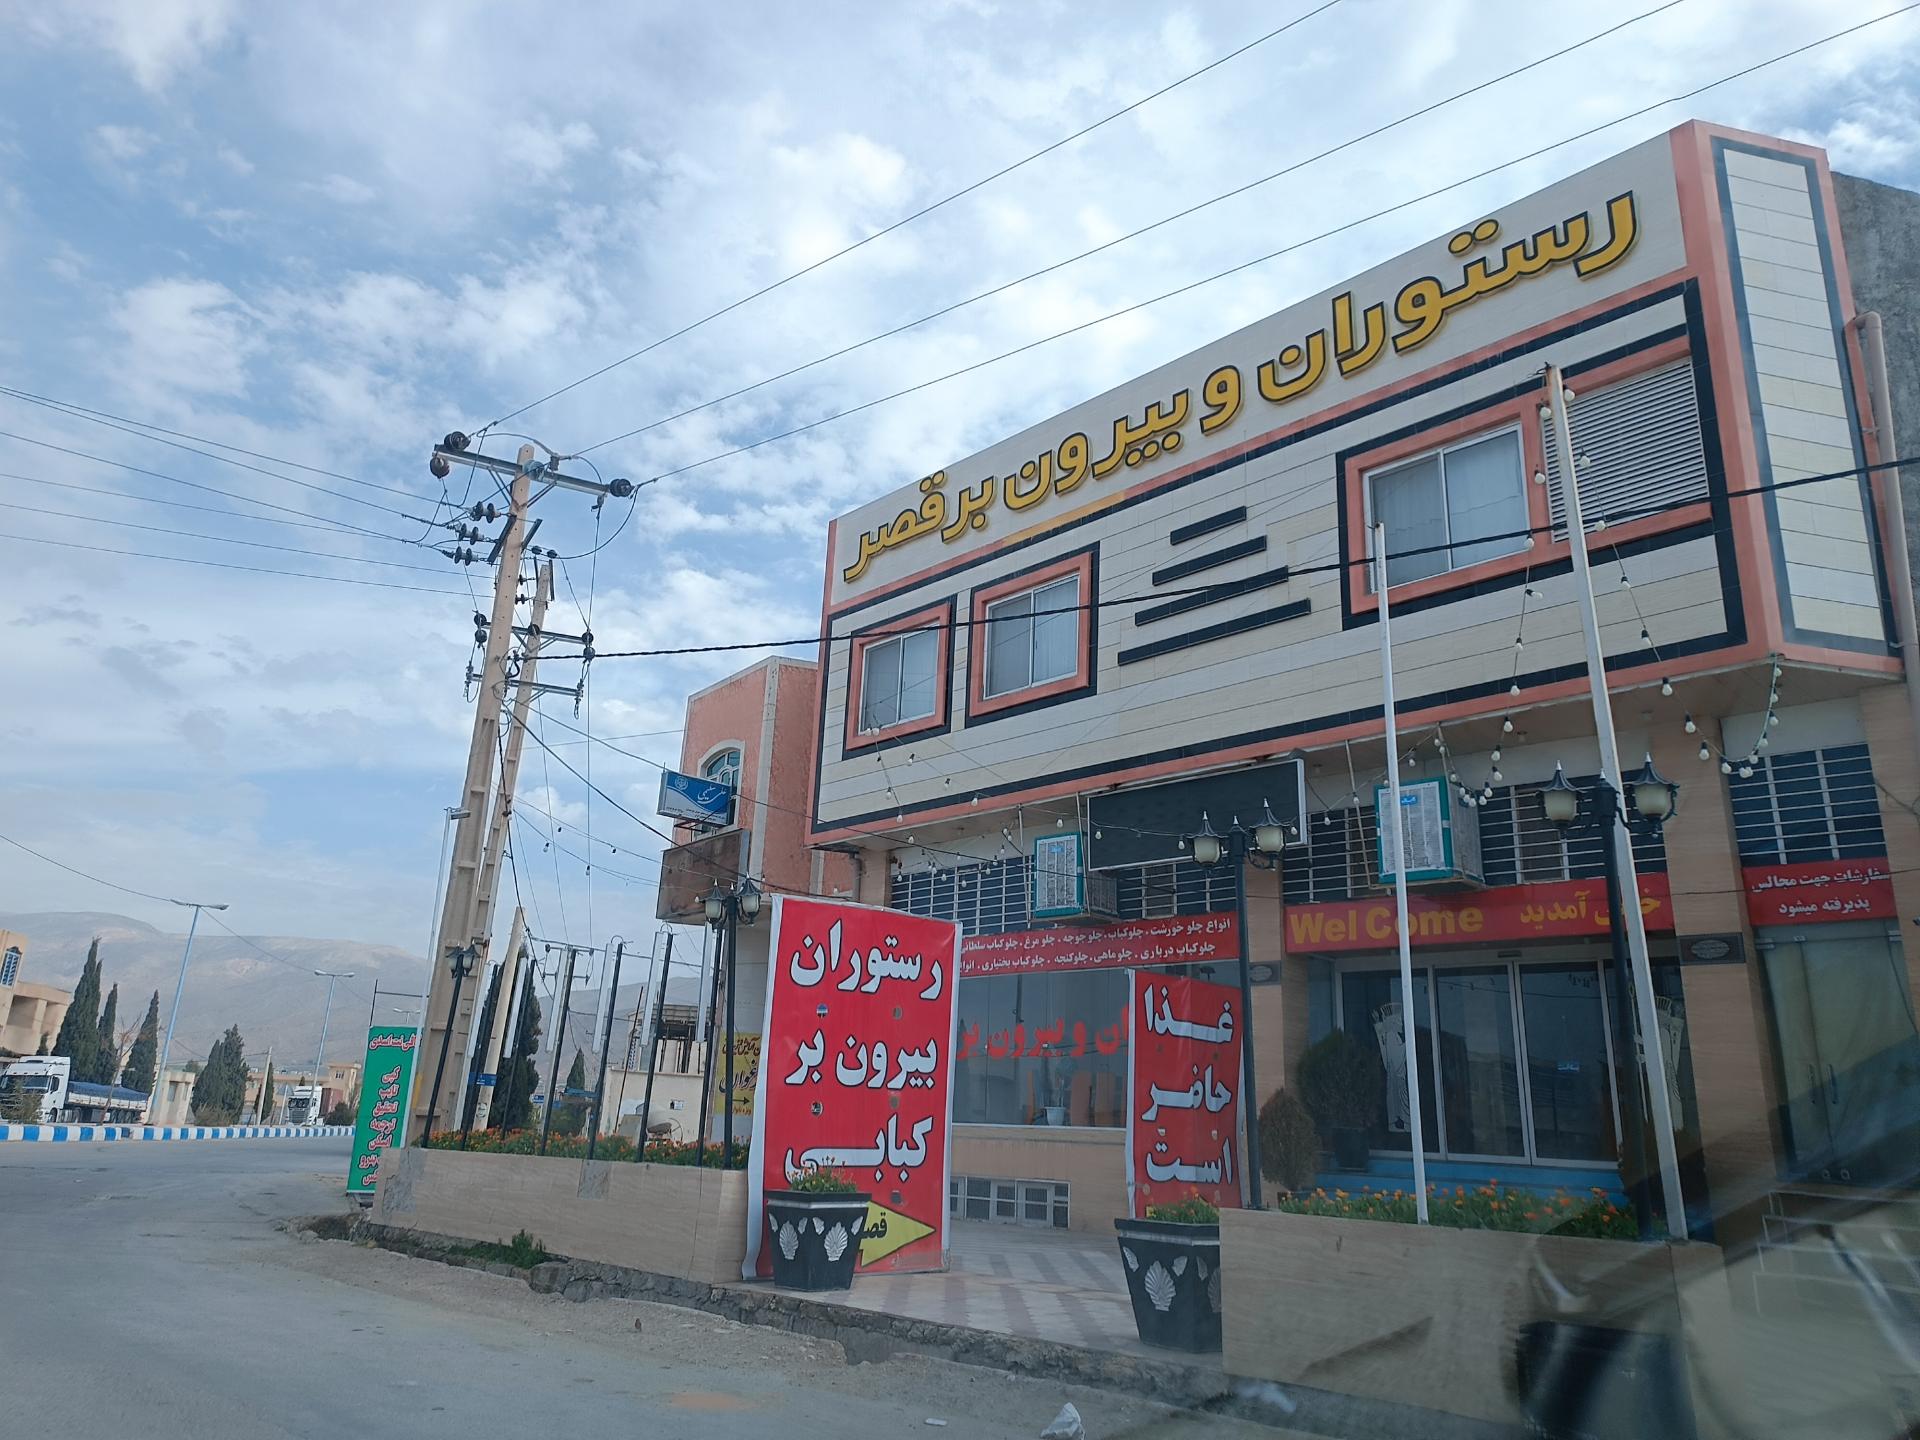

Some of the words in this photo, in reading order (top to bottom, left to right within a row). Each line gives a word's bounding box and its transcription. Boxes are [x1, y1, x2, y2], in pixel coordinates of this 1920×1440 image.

[1256, 190, 1640, 402] رستوران
[1199, 364, 1243, 433] و
[1002, 389, 1190, 511] بیرون
[843, 469, 948, 581] قصر
[940, 473, 994, 543] بر
[1290, 910, 1357, 944] Wel
[789, 919, 944, 1001] رستوران
[1143, 983, 1234, 1044] غذا
[784, 1028, 826, 1085] بر
[834, 1033, 938, 1090] بیرون
[1141, 1064, 1232, 1121] حاضر
[784, 1113, 934, 1184] کبابی
[1145, 1136, 1233, 1184] است
[860, 1211, 888, 1239] قص
